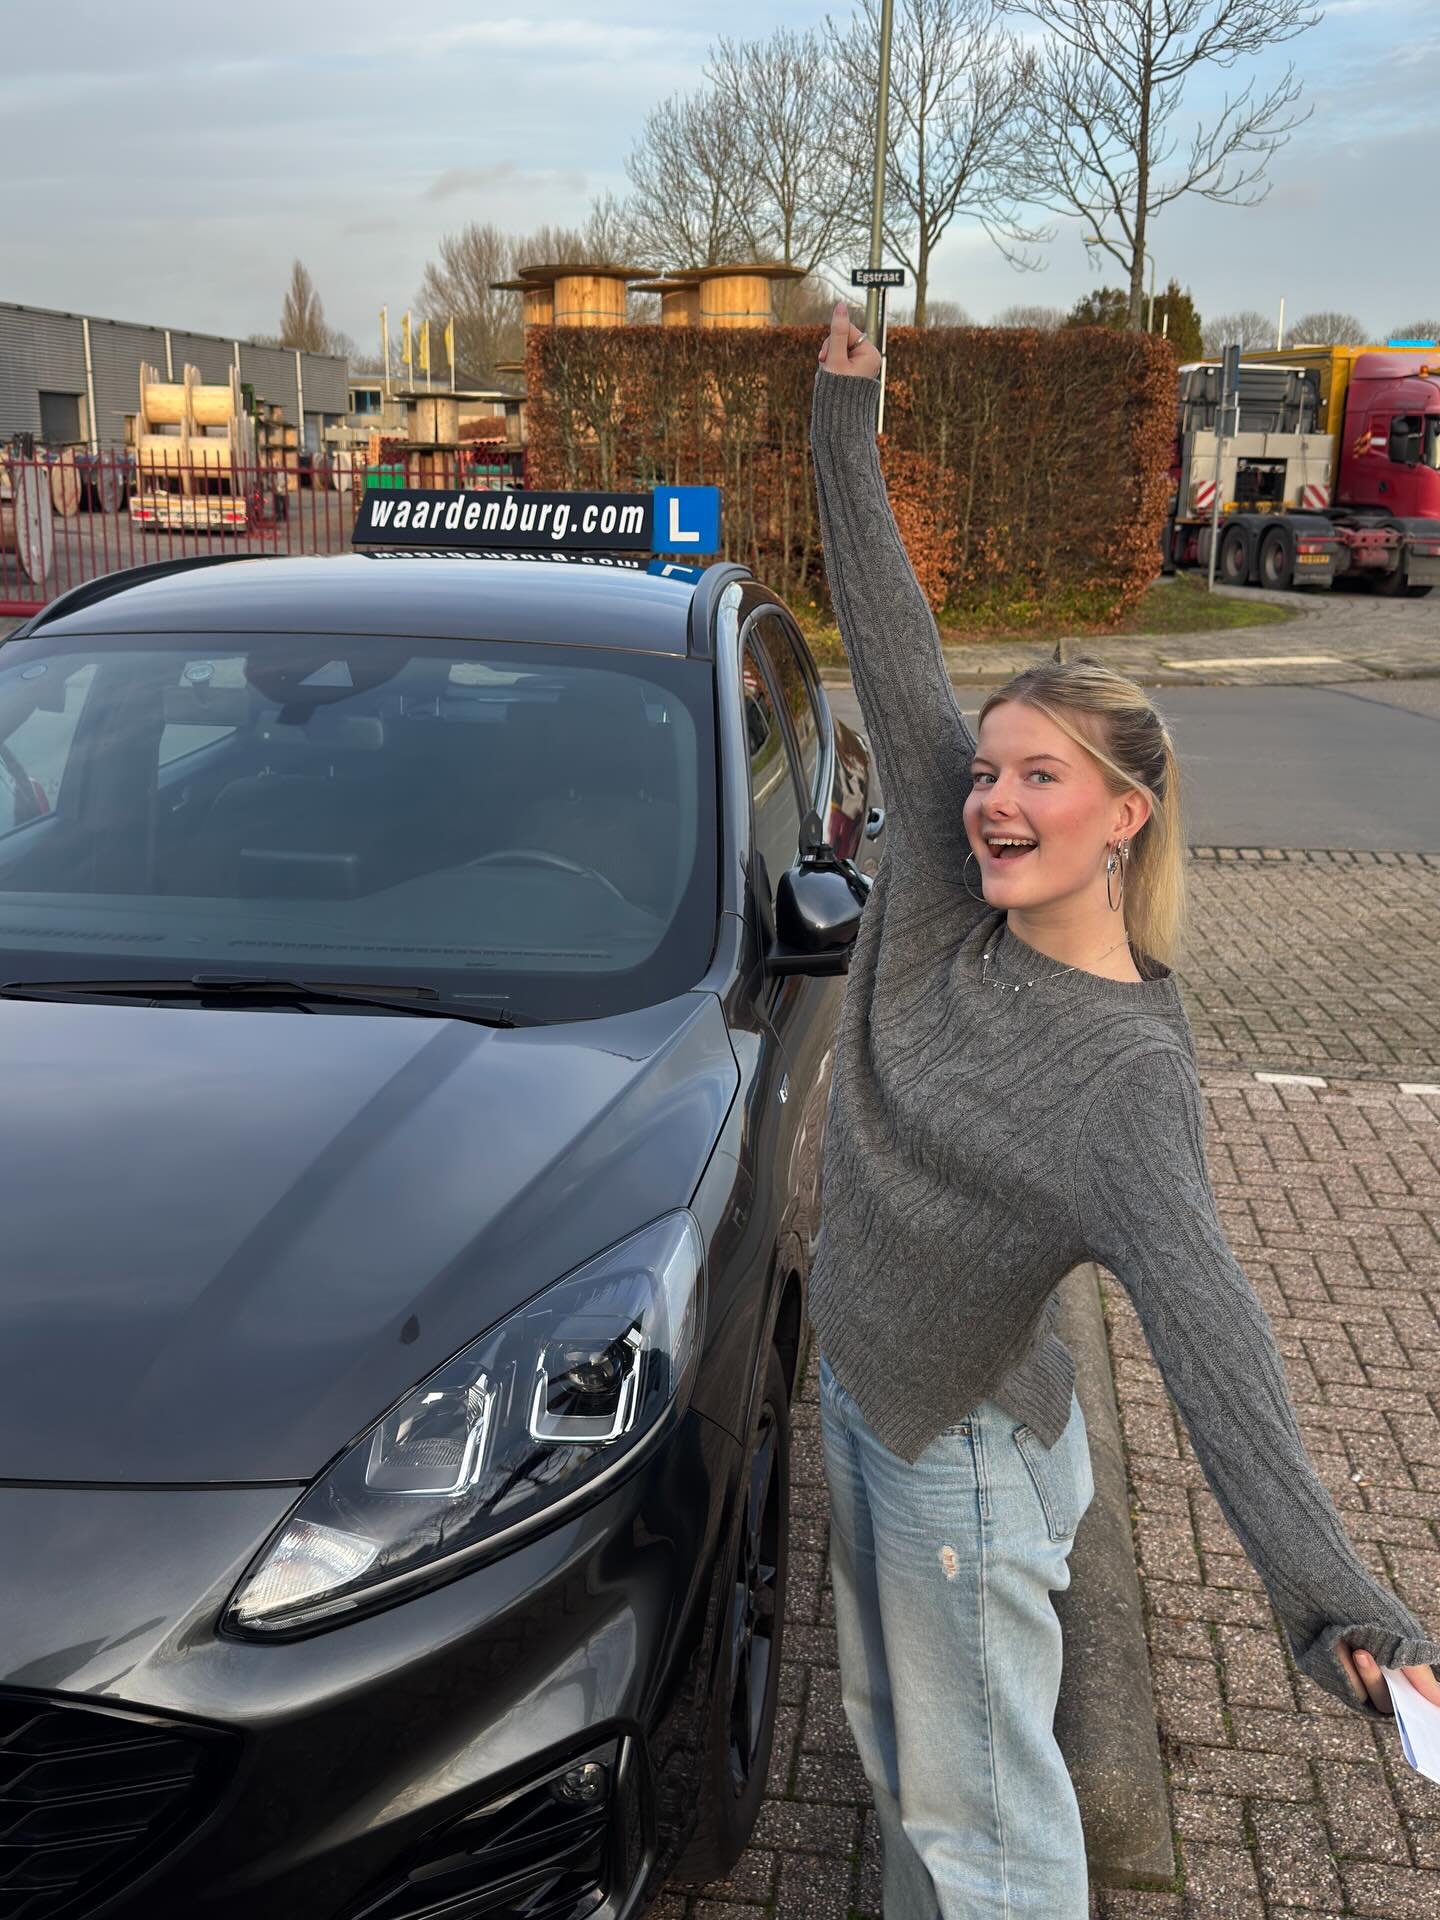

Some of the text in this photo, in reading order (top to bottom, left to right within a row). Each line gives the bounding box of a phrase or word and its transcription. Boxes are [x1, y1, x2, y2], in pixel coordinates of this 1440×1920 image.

[856, 271, 900, 284] Egstraat
[370, 495, 645, 540] waardenburg.com
[669, 497, 700, 542] L
